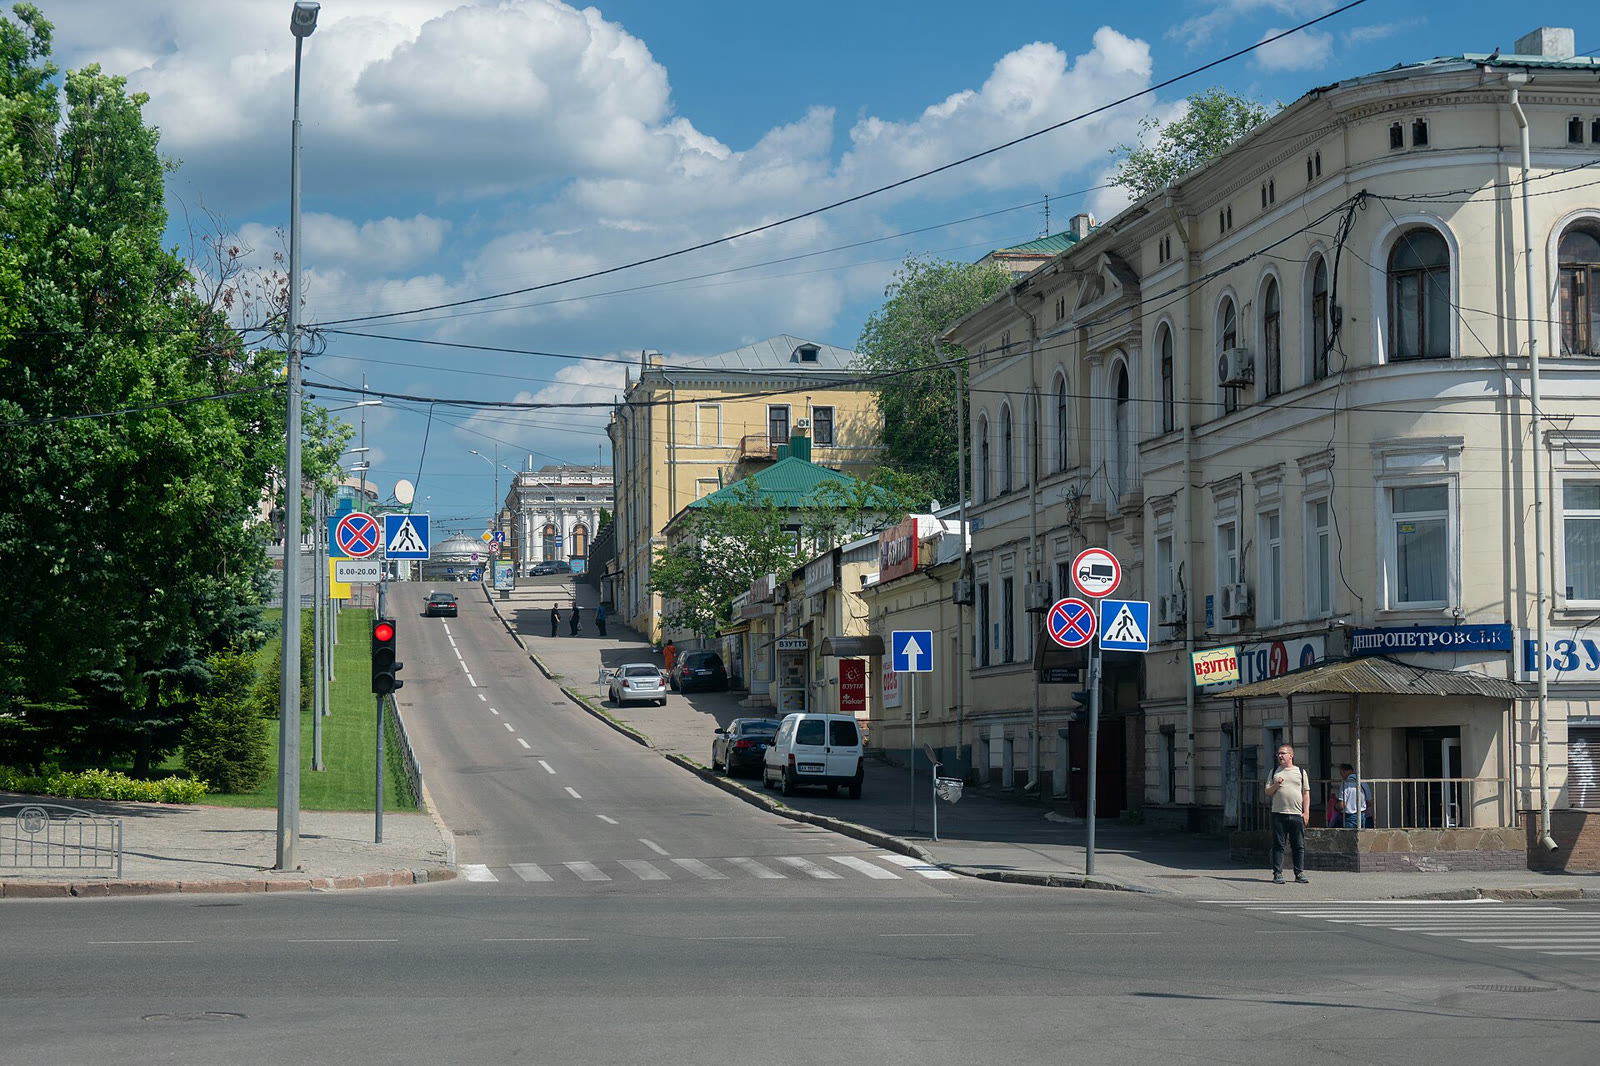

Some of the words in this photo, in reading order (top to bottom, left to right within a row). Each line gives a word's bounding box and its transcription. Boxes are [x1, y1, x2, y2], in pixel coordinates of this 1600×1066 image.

[339, 568, 377, 576] 8.00-20.00
[779, 640, 807, 648] ВЗУТТЯ
[1194, 657, 1237, 676] ВЗУТТЯ
